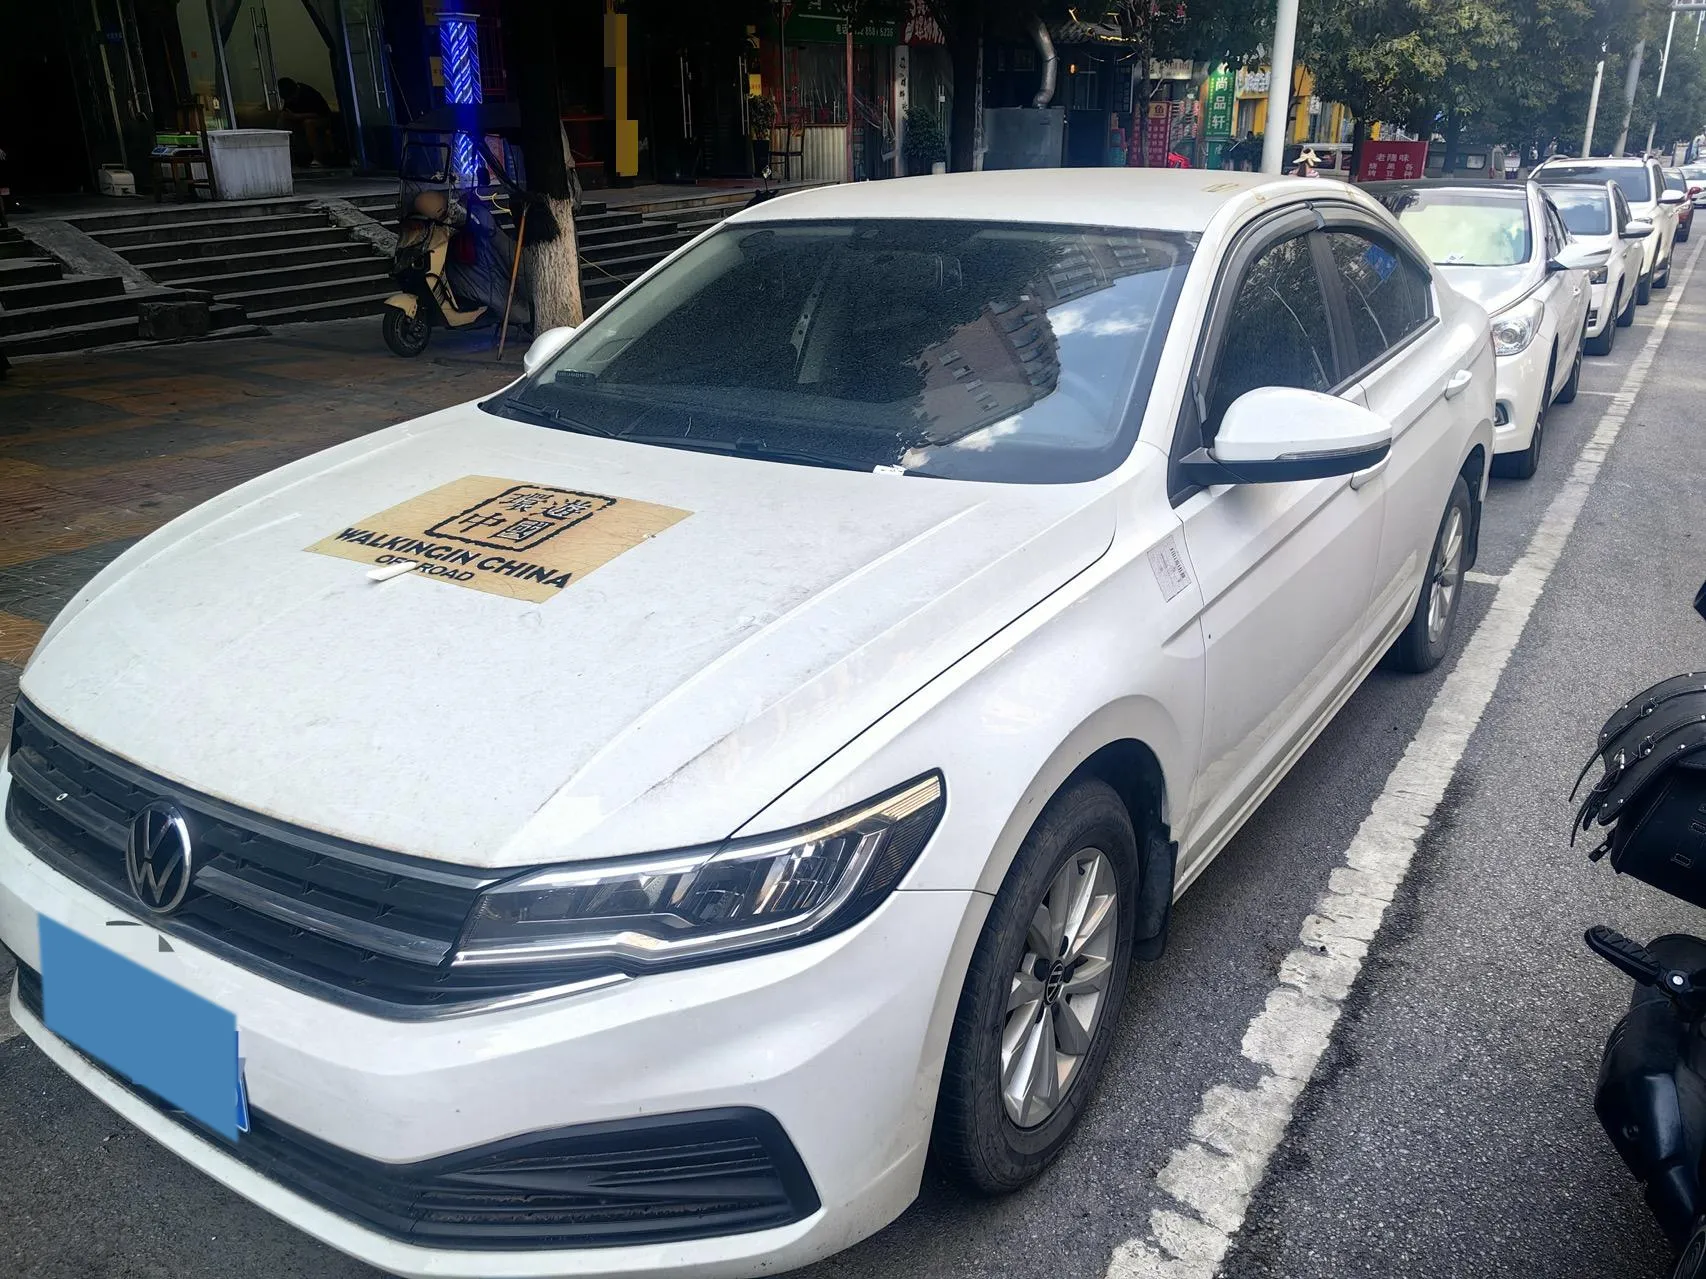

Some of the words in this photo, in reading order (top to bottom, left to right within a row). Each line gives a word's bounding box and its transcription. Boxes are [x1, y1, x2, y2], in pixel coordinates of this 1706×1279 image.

[1211, 77, 1228, 129] 尚品轩
[458, 512, 555, 543] 中國
[414, 562, 475, 581] ROAD
[476, 556, 573, 589] CHINA
